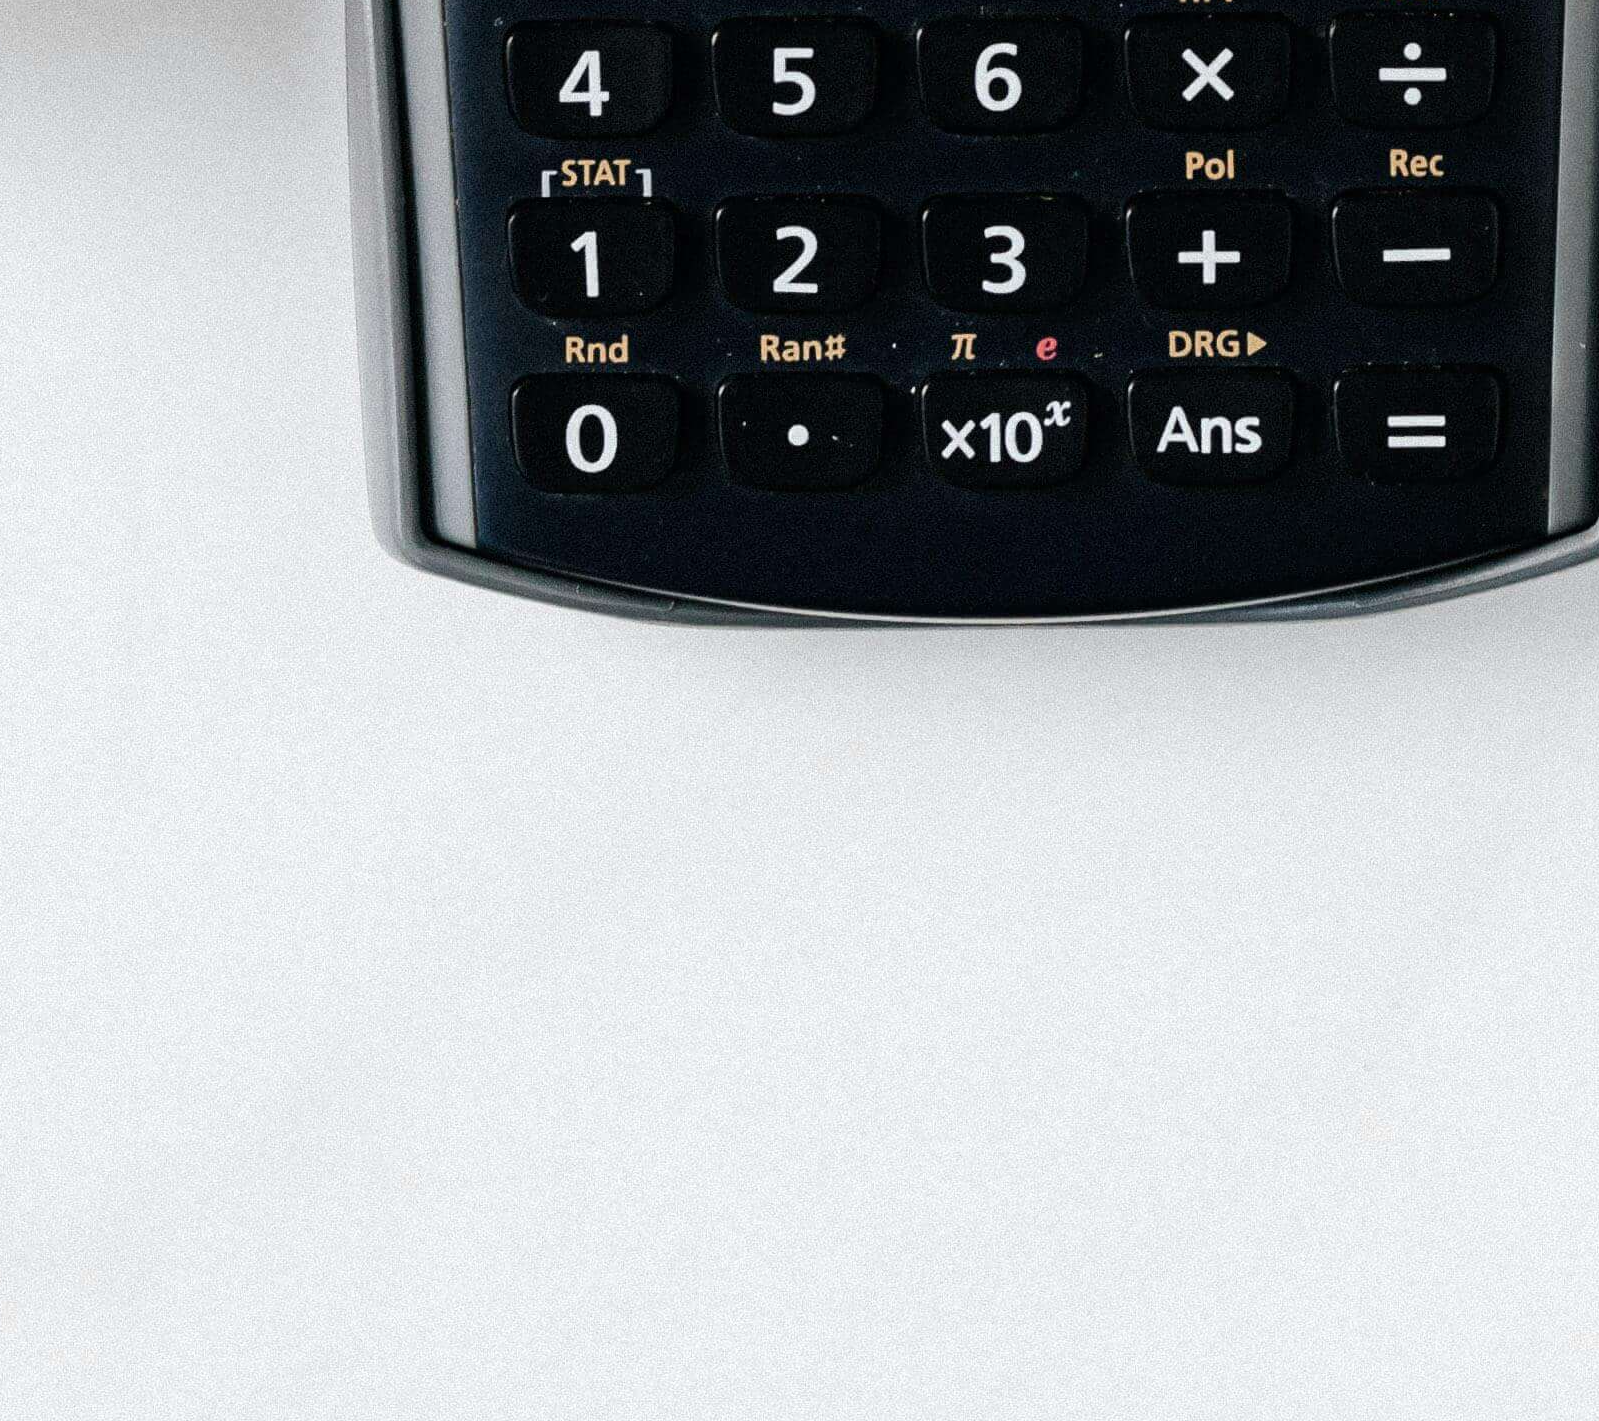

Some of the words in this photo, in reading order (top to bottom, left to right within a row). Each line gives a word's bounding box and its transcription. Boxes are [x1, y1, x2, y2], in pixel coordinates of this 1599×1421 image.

[558, 49, 610, 117] 4
[772, 47, 816, 116] 5
[974, 42, 1023, 112] 6
[561, 158, 631, 187] STAT
[1185, 149, 1235, 181] Pol
[1389, 148, 1444, 178] Rec
[570, 230, 600, 298] 1
[772, 225, 819, 294] 2
[981, 225, 1027, 295] 3
[565, 334, 629, 364] Rnd
[759, 334, 846, 363] Ran#
[1168, 329, 1240, 358] DRG
[565, 403, 618, 474] 0
[1156, 405, 1263, 455] Ans
